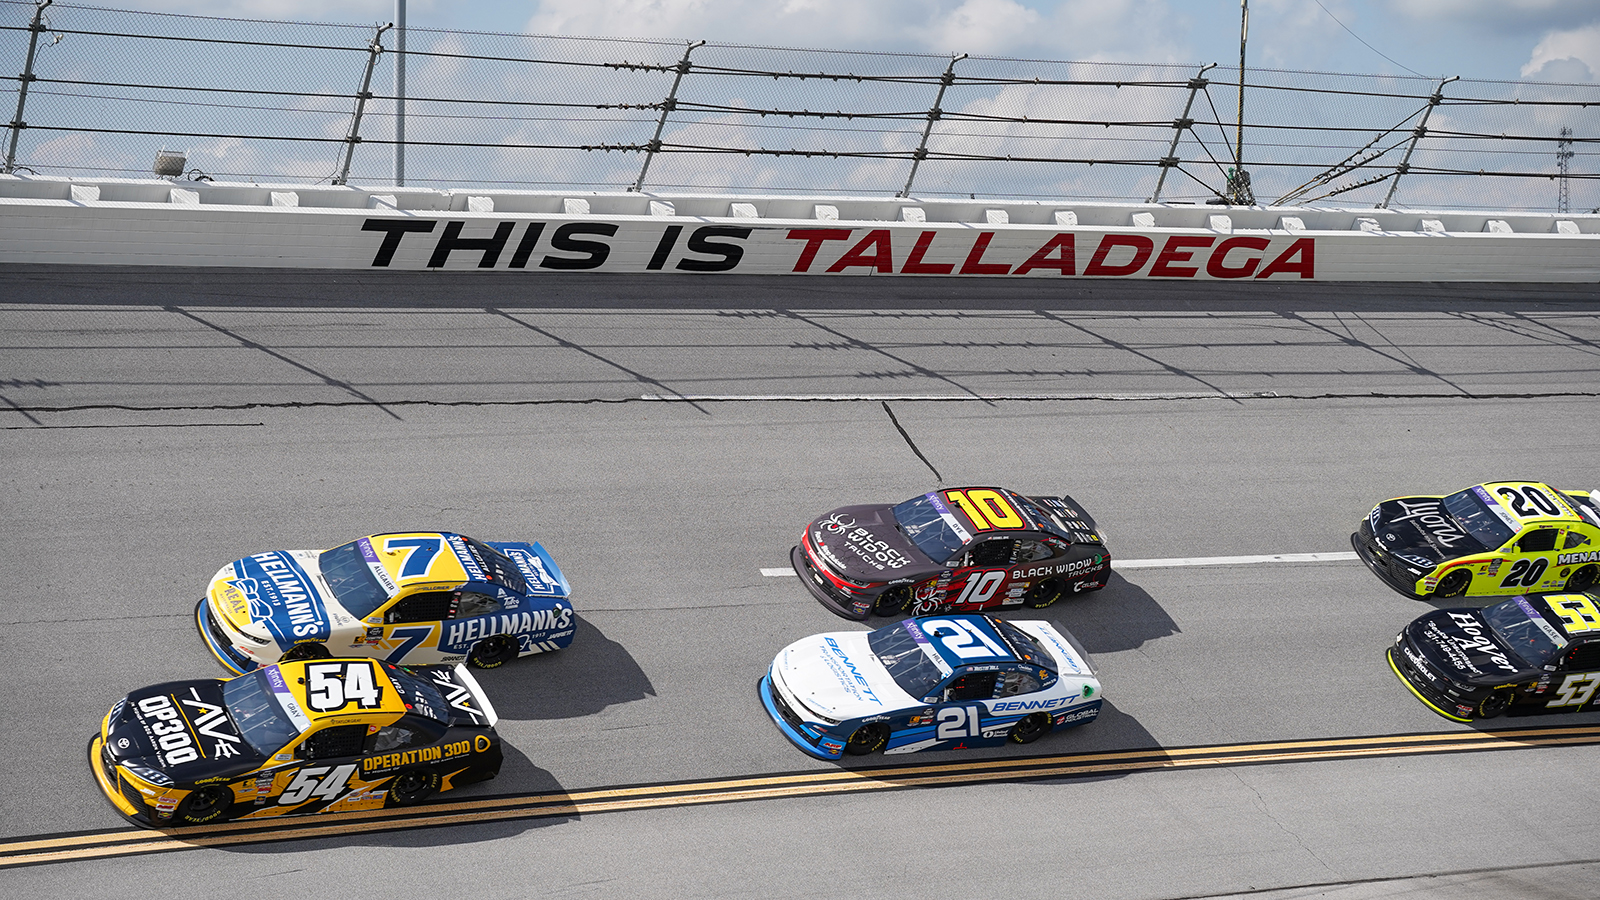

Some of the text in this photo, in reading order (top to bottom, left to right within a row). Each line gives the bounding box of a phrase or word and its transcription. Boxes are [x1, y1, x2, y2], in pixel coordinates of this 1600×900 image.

[361, 218, 1315, 279] THIS IS TALLADEGA
[929, 494, 944, 510] xfinity
[946, 489, 1024, 530] 10
[1476, 487, 1492, 503] xfinity
[1497, 486, 1560, 517] 20
[952, 523, 963, 534] DYE
[1391, 500, 1465, 548] Lyons
[1500, 511, 1514, 525] JONES
[360, 540, 374, 558] xfinity
[386, 538, 442, 578] 7
[448, 536, 487, 581] HELLMANN'S
[844, 541, 885, 571] TRUCKS
[847, 532, 903, 569] WIDOW
[854, 527, 911, 566] BLACK
[1558, 551, 1600, 564] MENA
[374, 566, 395, 591] ALLGAIER
[509, 551, 546, 590] HELLMANN'S
[1012, 558, 1092, 580] BLACK WIDOW
[1068, 564, 1104, 578] TRUCKS
[1500, 558, 1548, 588] 20
[224, 588, 246, 614] REAL
[251, 552, 323, 637] HELLMANN'S
[955, 571, 1006, 604] 10
[1518, 598, 1535, 616] xfinity
[1542, 595, 1600, 633] 53
[448, 603, 573, 646] HELLMANN'S
[532, 632, 546, 640] 1913
[907, 622, 924, 640] xfinity
[922, 619, 1010, 658] 21
[1543, 624, 1559, 640] GASE
[385, 626, 435, 665] 7
[932, 652, 942, 664] HILL
[268, 668, 284, 688] xfinity
[824, 636, 883, 706] BENNETT
[1403, 646, 1437, 682] CHEVROLET
[308, 663, 379, 710] 54
[1545, 672, 1600, 708] 53
[287, 702, 300, 718] GRAY
[991, 694, 1081, 712] BENNETT
[1066, 708, 1099, 720] GLOBAL
[138, 695, 199, 765] OP300
[937, 706, 979, 740] 21
[363, 746, 442, 772] OPERATION
[278, 763, 358, 804] 54
